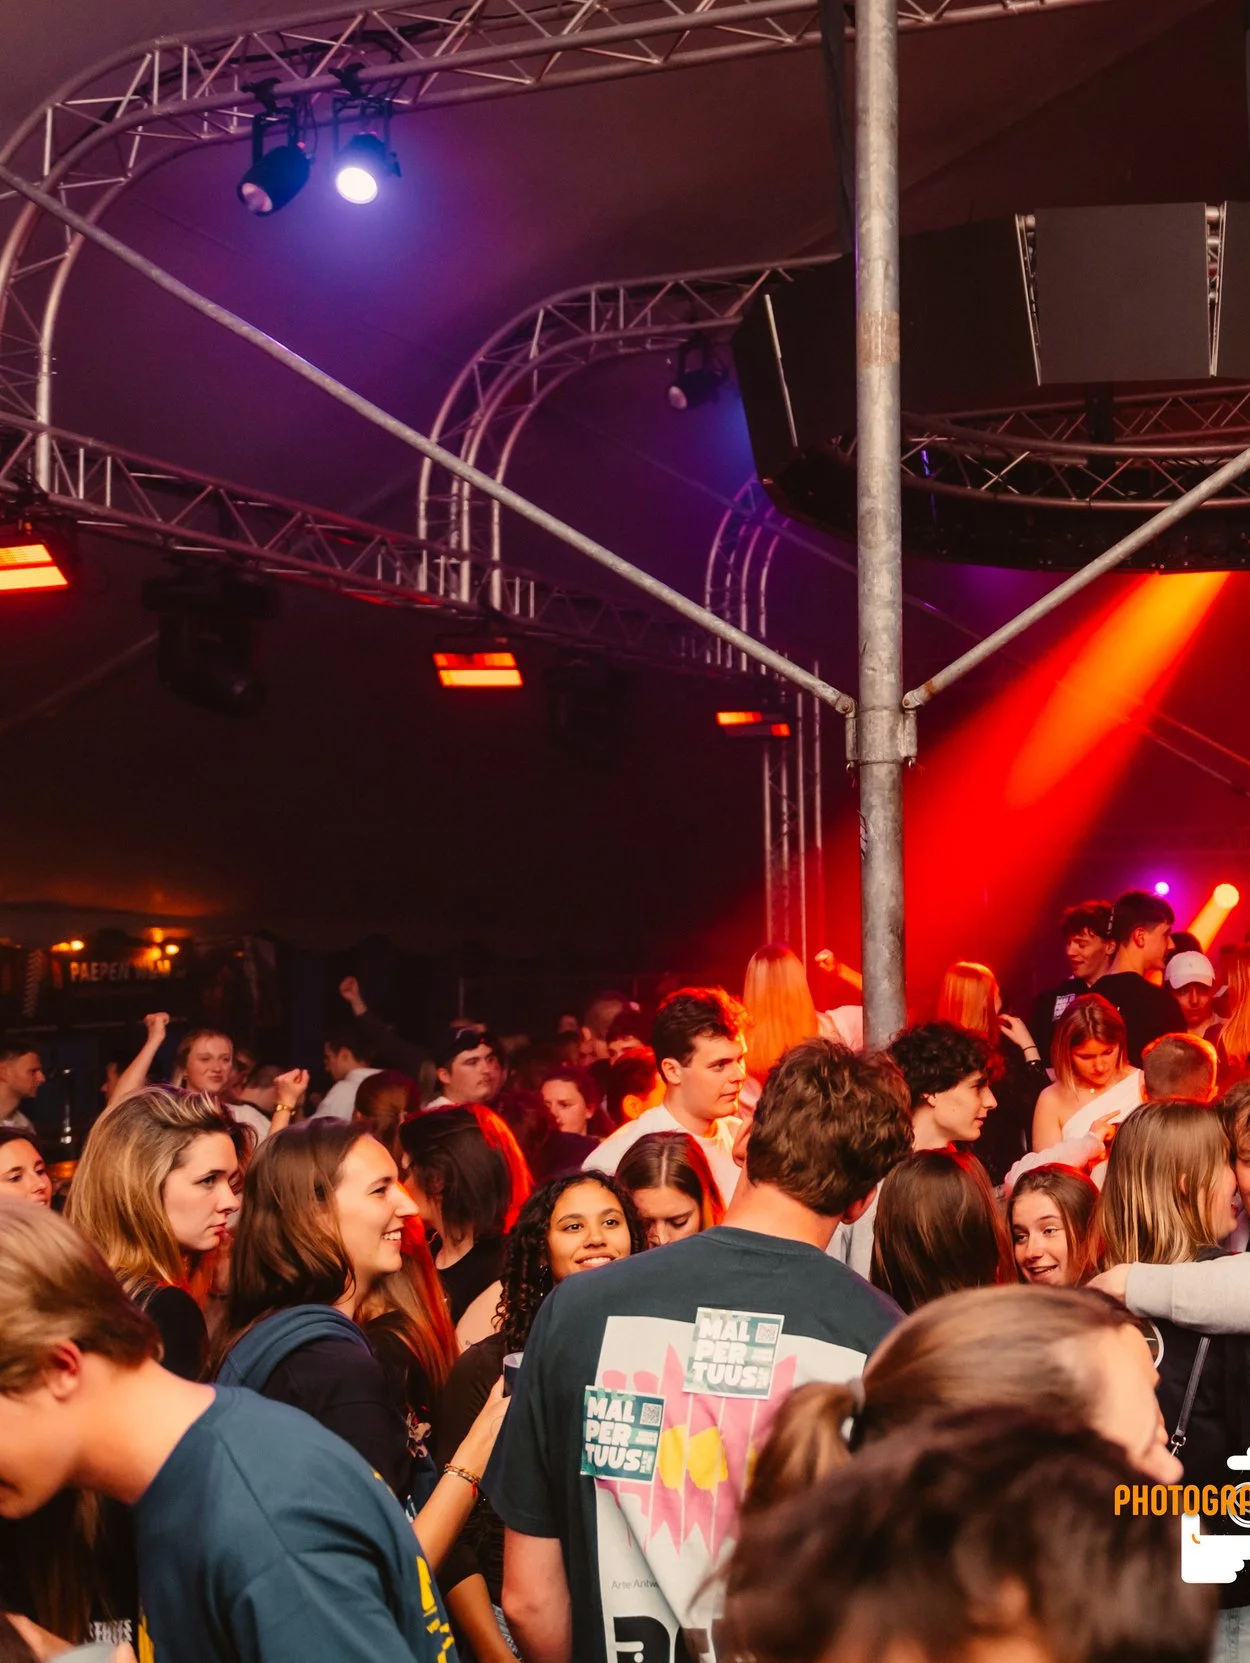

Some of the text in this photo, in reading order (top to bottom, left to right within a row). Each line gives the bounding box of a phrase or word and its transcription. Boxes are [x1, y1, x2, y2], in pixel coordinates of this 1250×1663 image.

[698, 1317, 750, 1342] MAL
[694, 1339, 748, 1365] PER
[692, 1361, 758, 1387] TUUS
[587, 1396, 635, 1423] MAL
[585, 1419, 632, 1447] PER
[585, 1442, 642, 1472] TUUS
[611, 1580, 631, 1590] Arte
